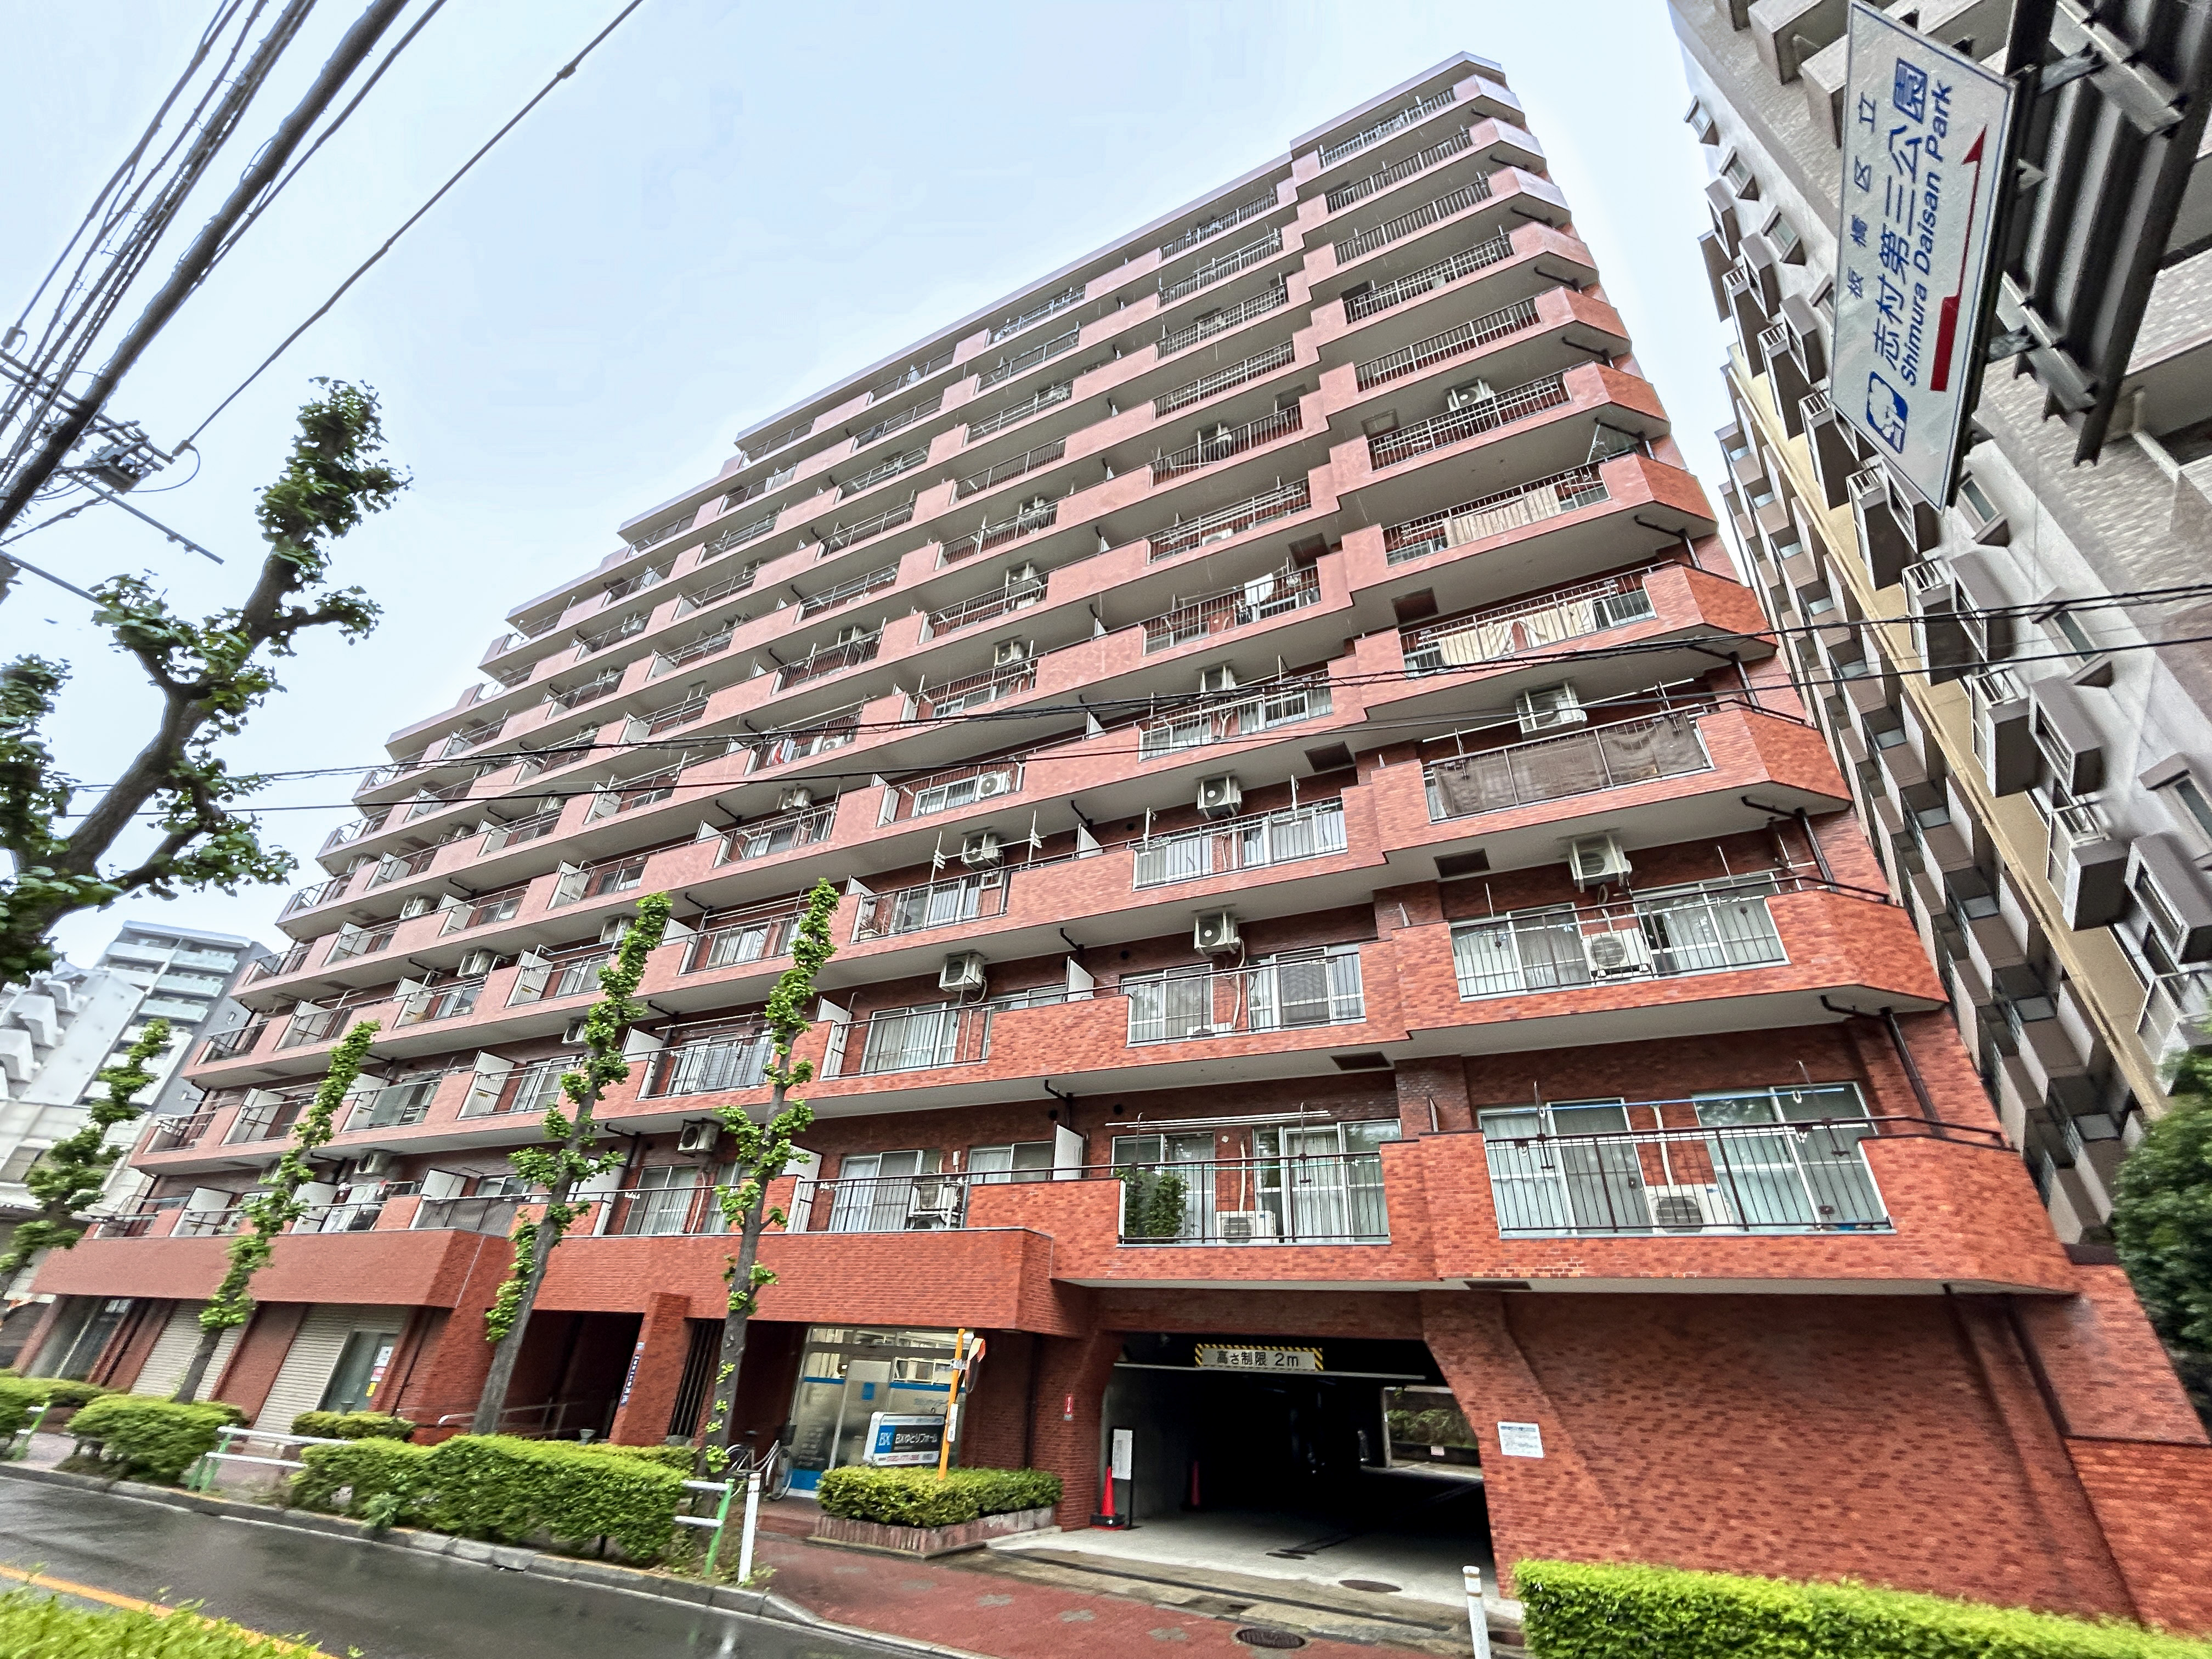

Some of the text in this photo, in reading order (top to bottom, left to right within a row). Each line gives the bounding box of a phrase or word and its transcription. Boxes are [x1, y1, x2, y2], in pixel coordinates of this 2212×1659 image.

[1874, 58, 1928, 370] 志村第三公園
[1900, 79, 1953, 386] Shimura Daisan Park
[1217, 1350, 1299, 1367] 高さ制限 2m
